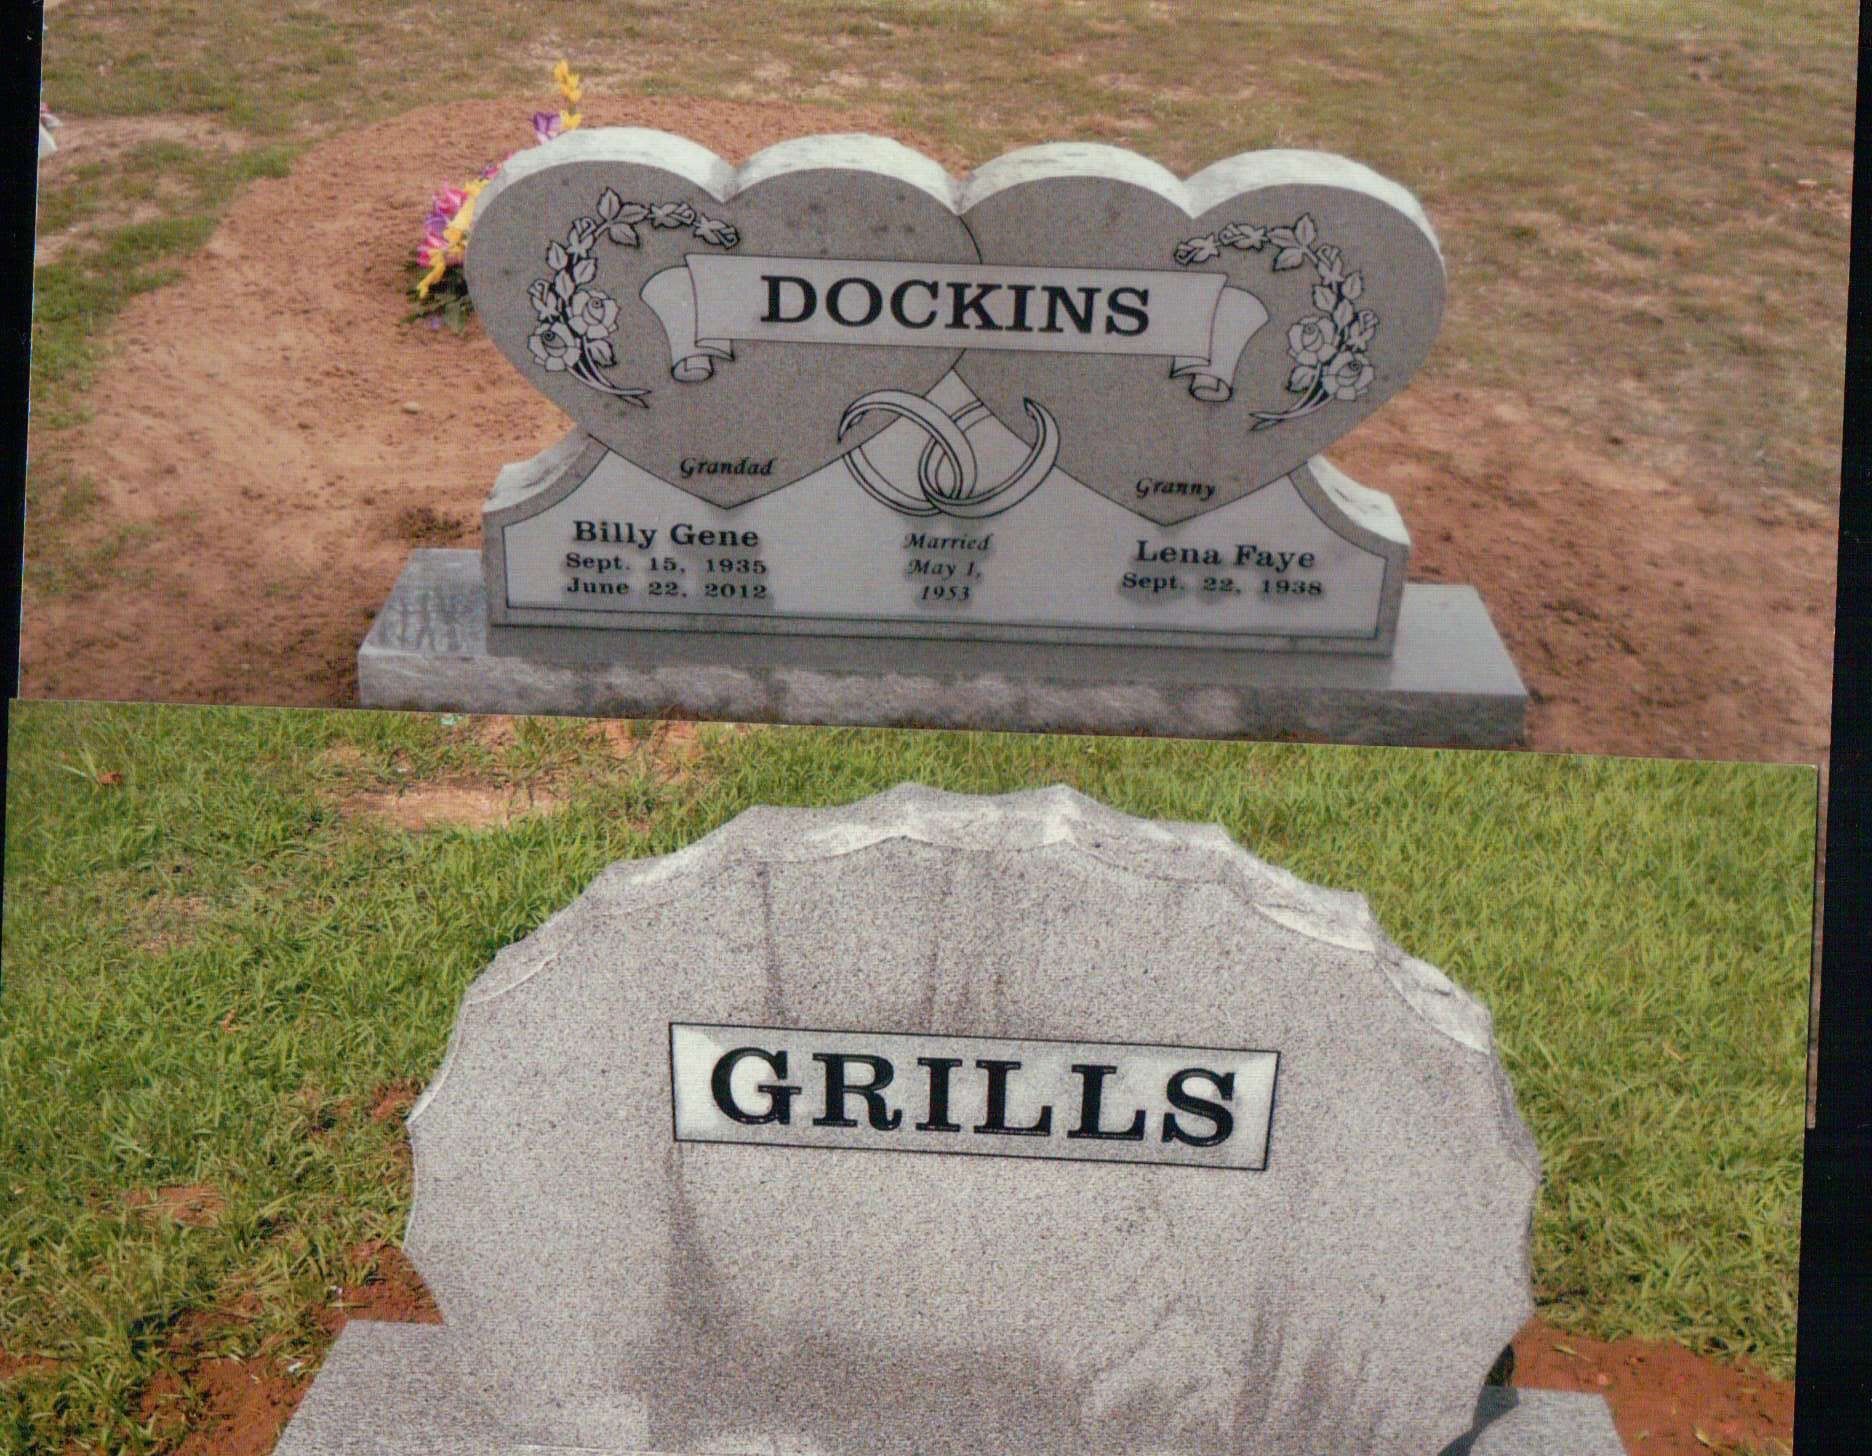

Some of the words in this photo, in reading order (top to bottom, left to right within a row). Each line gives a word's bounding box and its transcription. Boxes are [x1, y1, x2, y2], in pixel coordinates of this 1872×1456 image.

[760, 275, 1150, 336] DOCKINS
[680, 456, 774, 477] Grandad
[1135, 477, 1216, 500] Granny
[572, 520, 658, 550] Billy
[669, 523, 760, 547] Gene
[903, 532, 993, 551] Married
[566, 552, 631, 573] Sept.
[650, 557, 686, 573] 15,
[706, 558, 767, 575] 1935
[1136, 540, 1222, 566] Lena
[1233, 544, 1316, 572] Faye
[905, 559, 957, 580] May
[567, 578, 629, 596] June
[648, 582, 688, 598] 22,
[704, 582, 768, 599] 2012
[921, 585, 970, 601] 1953
[1121, 571, 1185, 593] Sept.
[1202, 576, 1242, 595] 22,
[1262, 579, 1323, 596] 1938
[710, 1046, 1236, 1147] GRILLS
